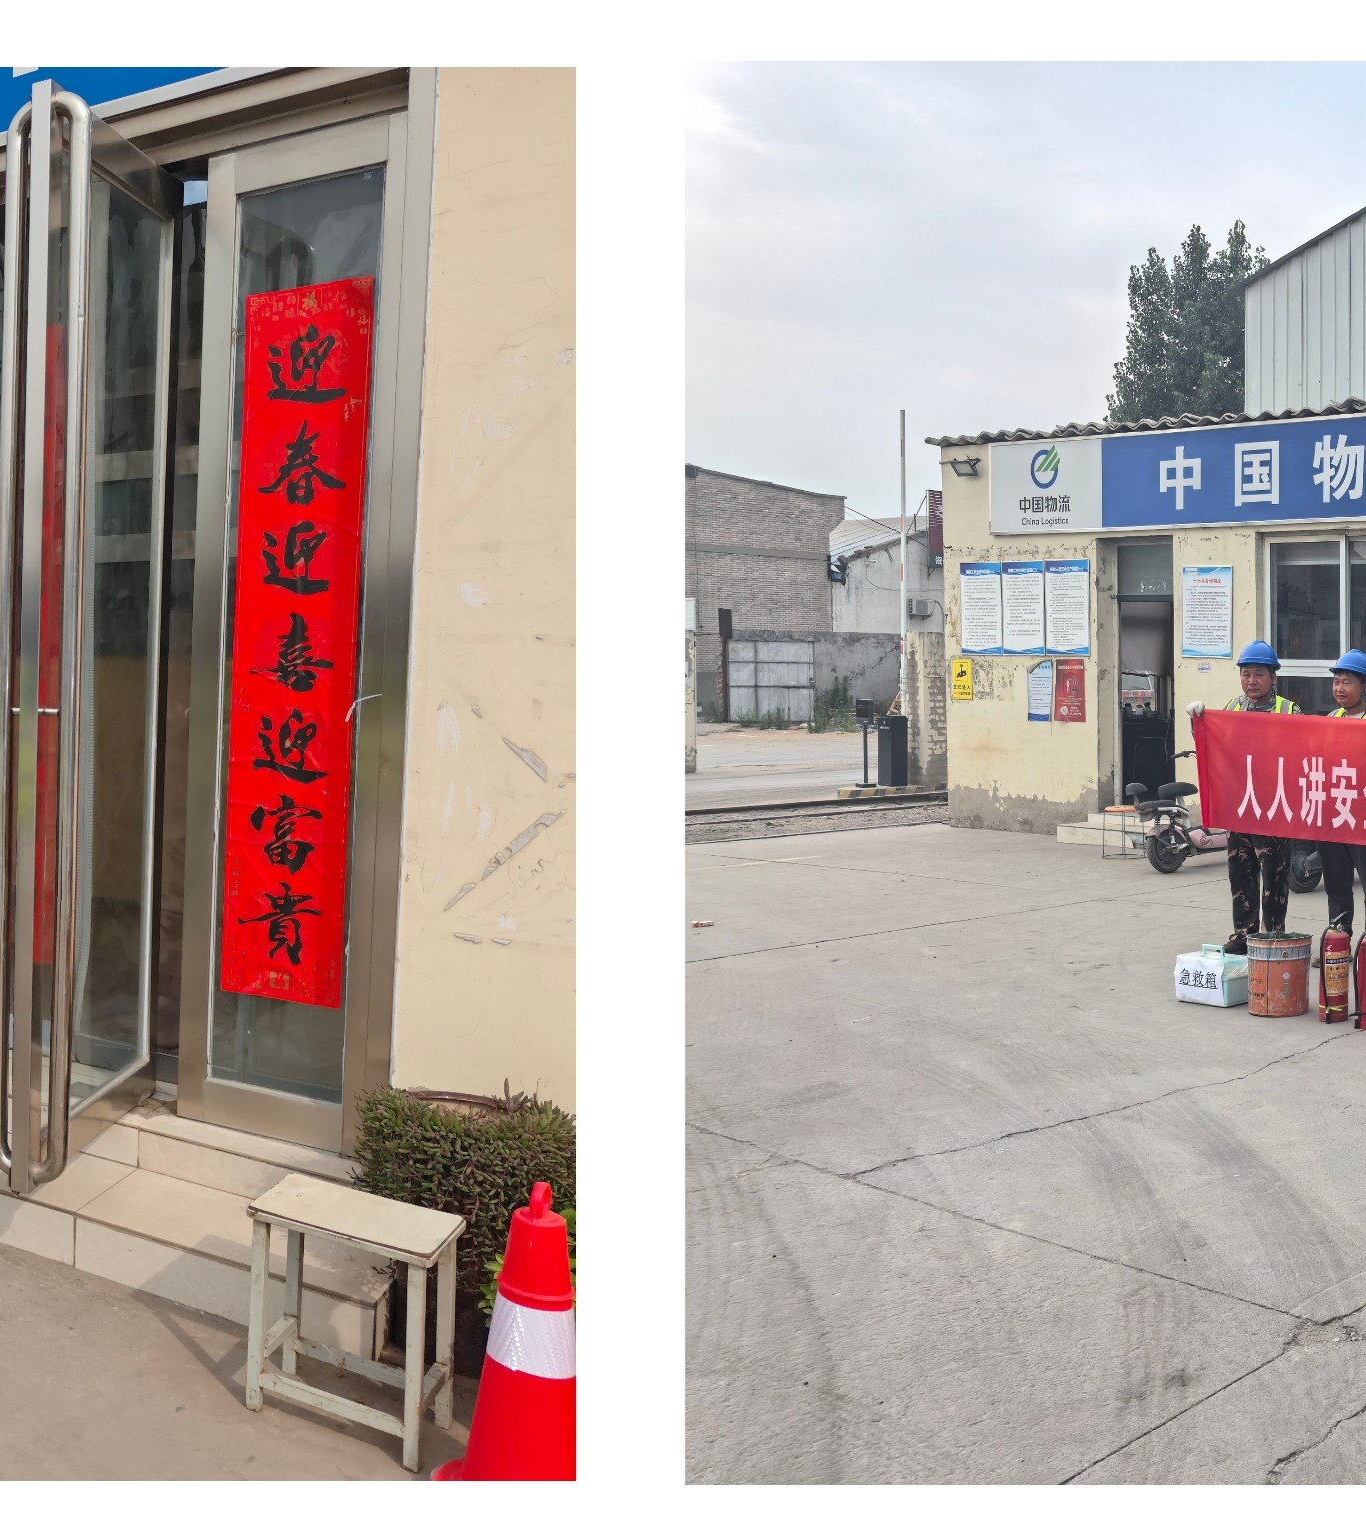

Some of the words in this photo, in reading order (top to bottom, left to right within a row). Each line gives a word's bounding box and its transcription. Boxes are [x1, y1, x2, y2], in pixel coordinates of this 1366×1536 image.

[1019, 495, 1071, 513] 中国物流
[1021, 517, 1040, 526] China
[1041, 517, 1069, 527] Logistics
[1179, 969, 1218, 990] 急救箱
